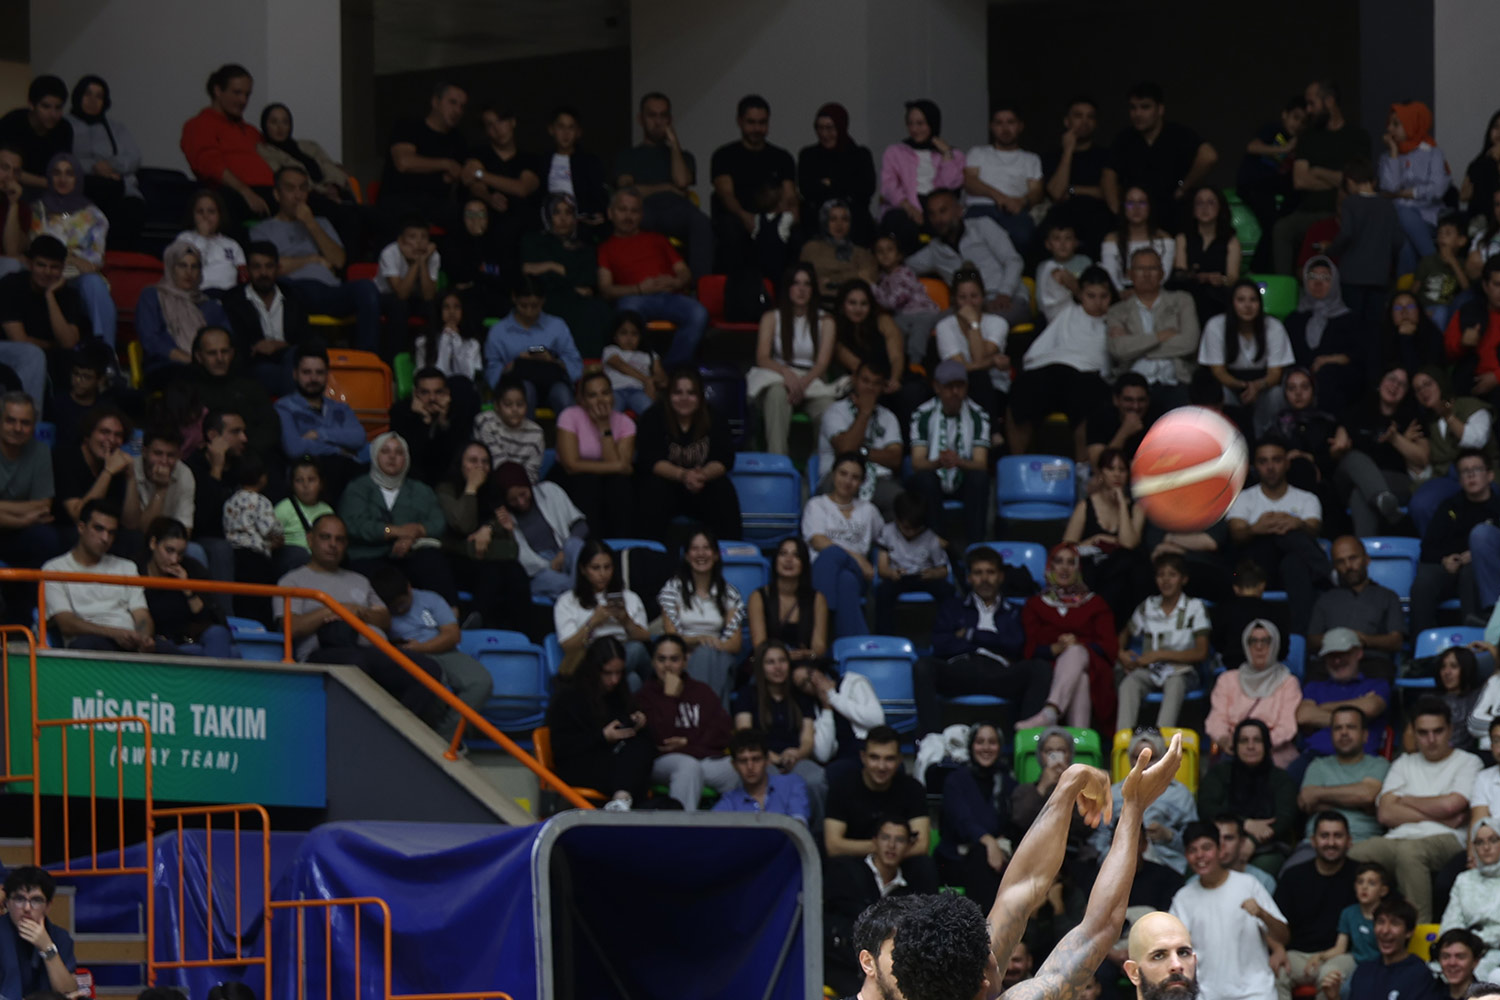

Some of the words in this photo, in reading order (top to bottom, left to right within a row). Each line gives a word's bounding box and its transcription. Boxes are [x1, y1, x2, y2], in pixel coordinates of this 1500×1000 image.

[71, 689, 176, 735] MİSAFİR
[190, 703, 267, 740] TAKIM
[181, 749, 239, 774] TEAM)
